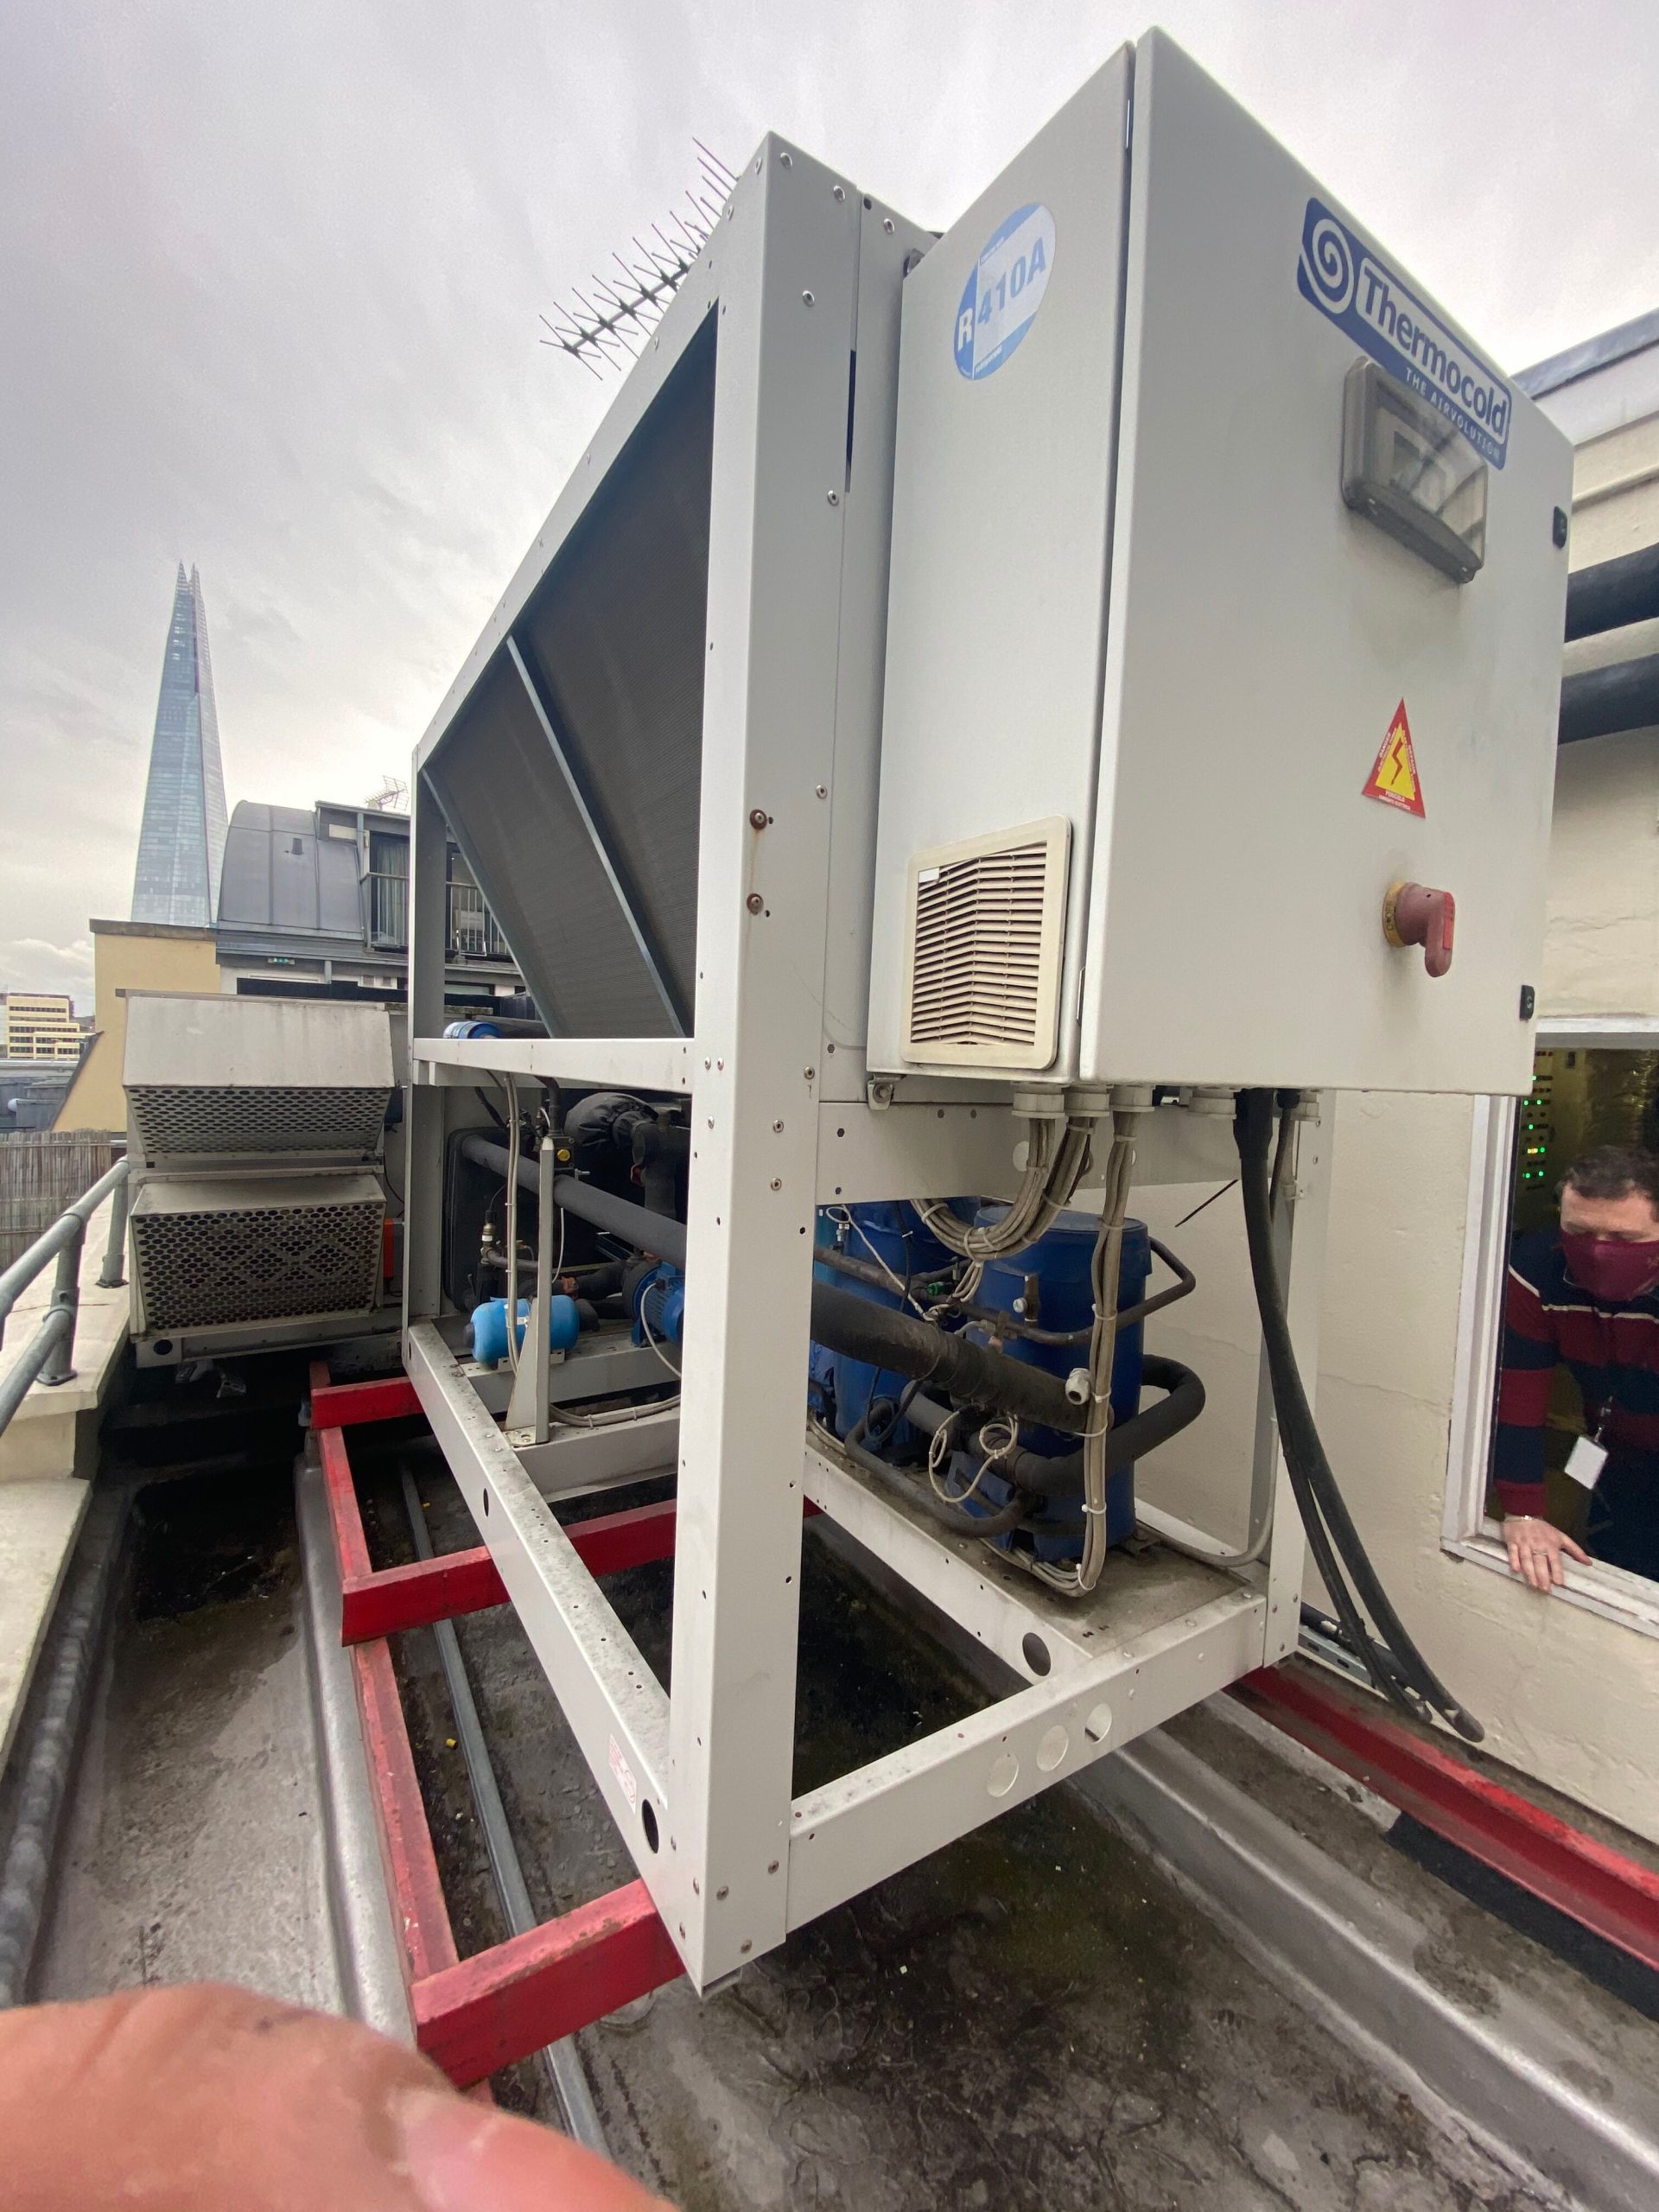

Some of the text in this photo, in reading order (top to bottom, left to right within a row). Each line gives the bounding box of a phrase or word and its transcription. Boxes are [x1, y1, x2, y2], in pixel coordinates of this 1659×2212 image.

[957, 237, 1046, 353] R410A
[1363, 265, 1507, 437] Thermocold
[1406, 366, 1500, 461] THE AIRVOLUTION
